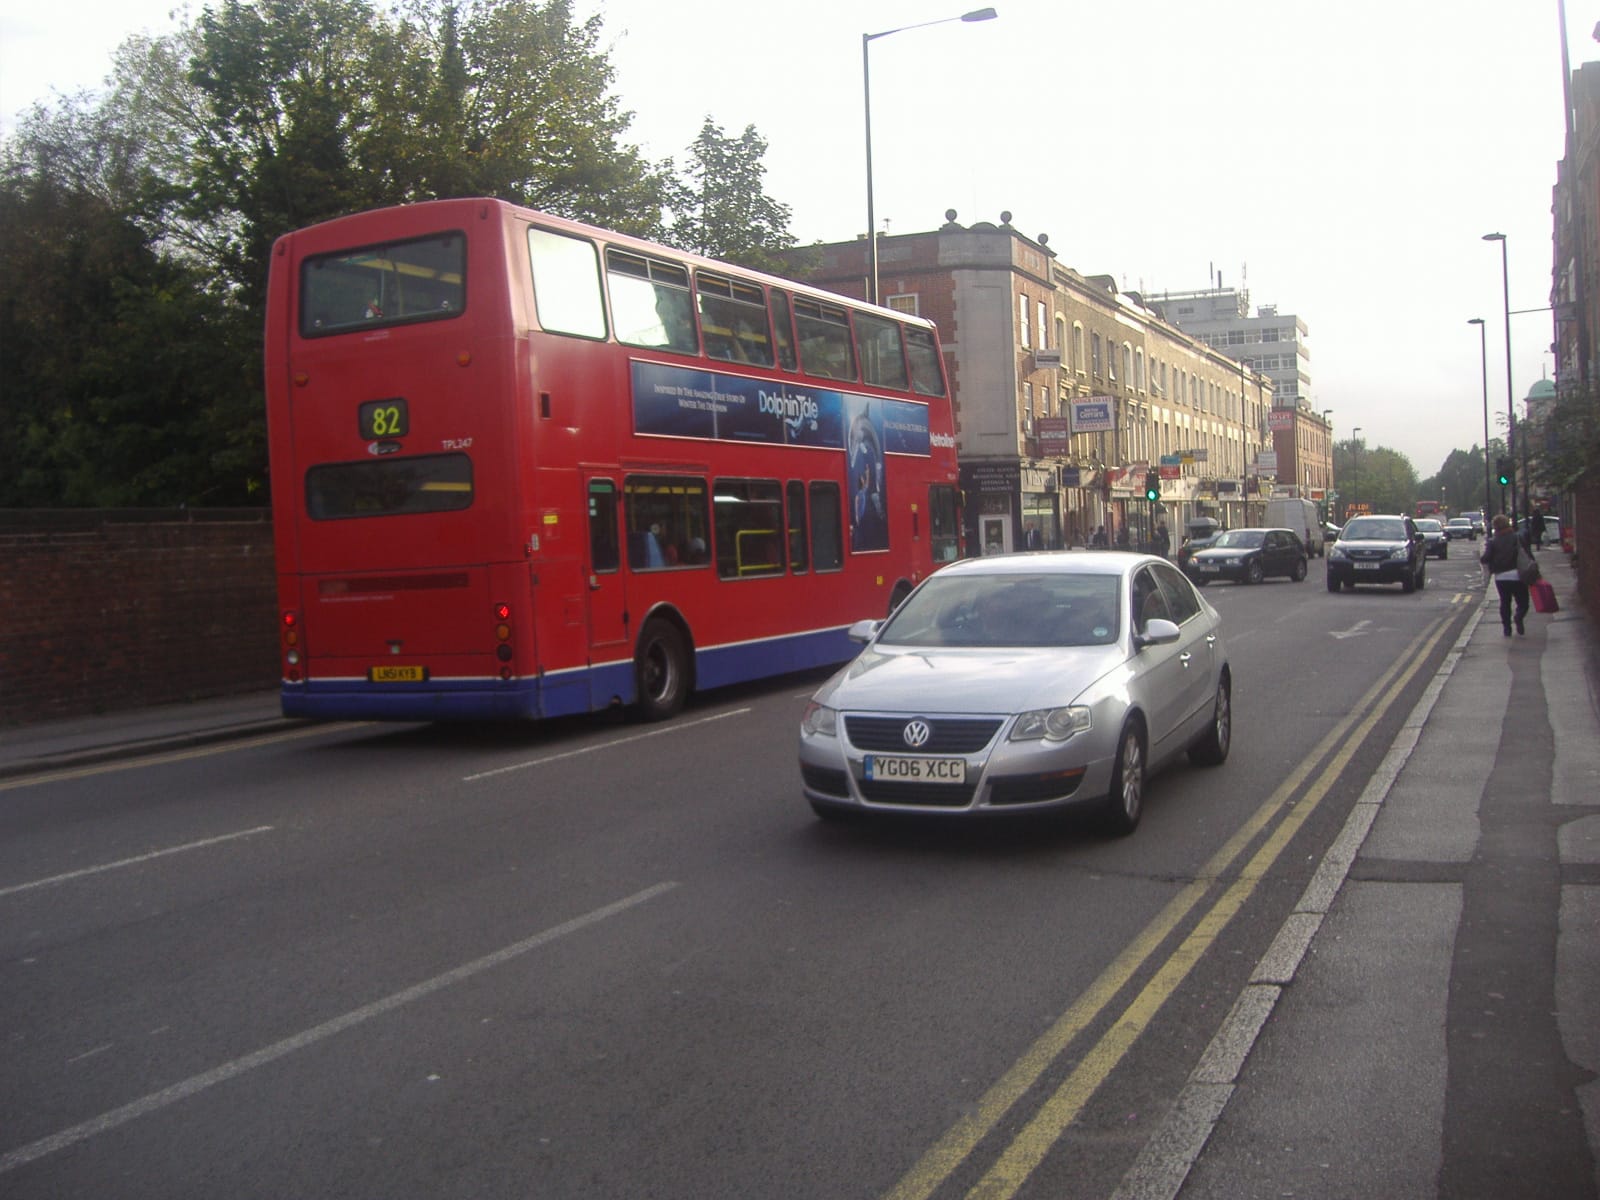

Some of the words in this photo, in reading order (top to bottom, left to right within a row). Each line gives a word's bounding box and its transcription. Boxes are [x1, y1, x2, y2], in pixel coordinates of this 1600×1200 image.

[758, 390, 799, 419] Dolphin
[373, 407, 401, 435] 82
[442, 437, 473, 450] TPL247
[874, 759, 921, 777] YG06
[926, 760, 960, 778] XCC
